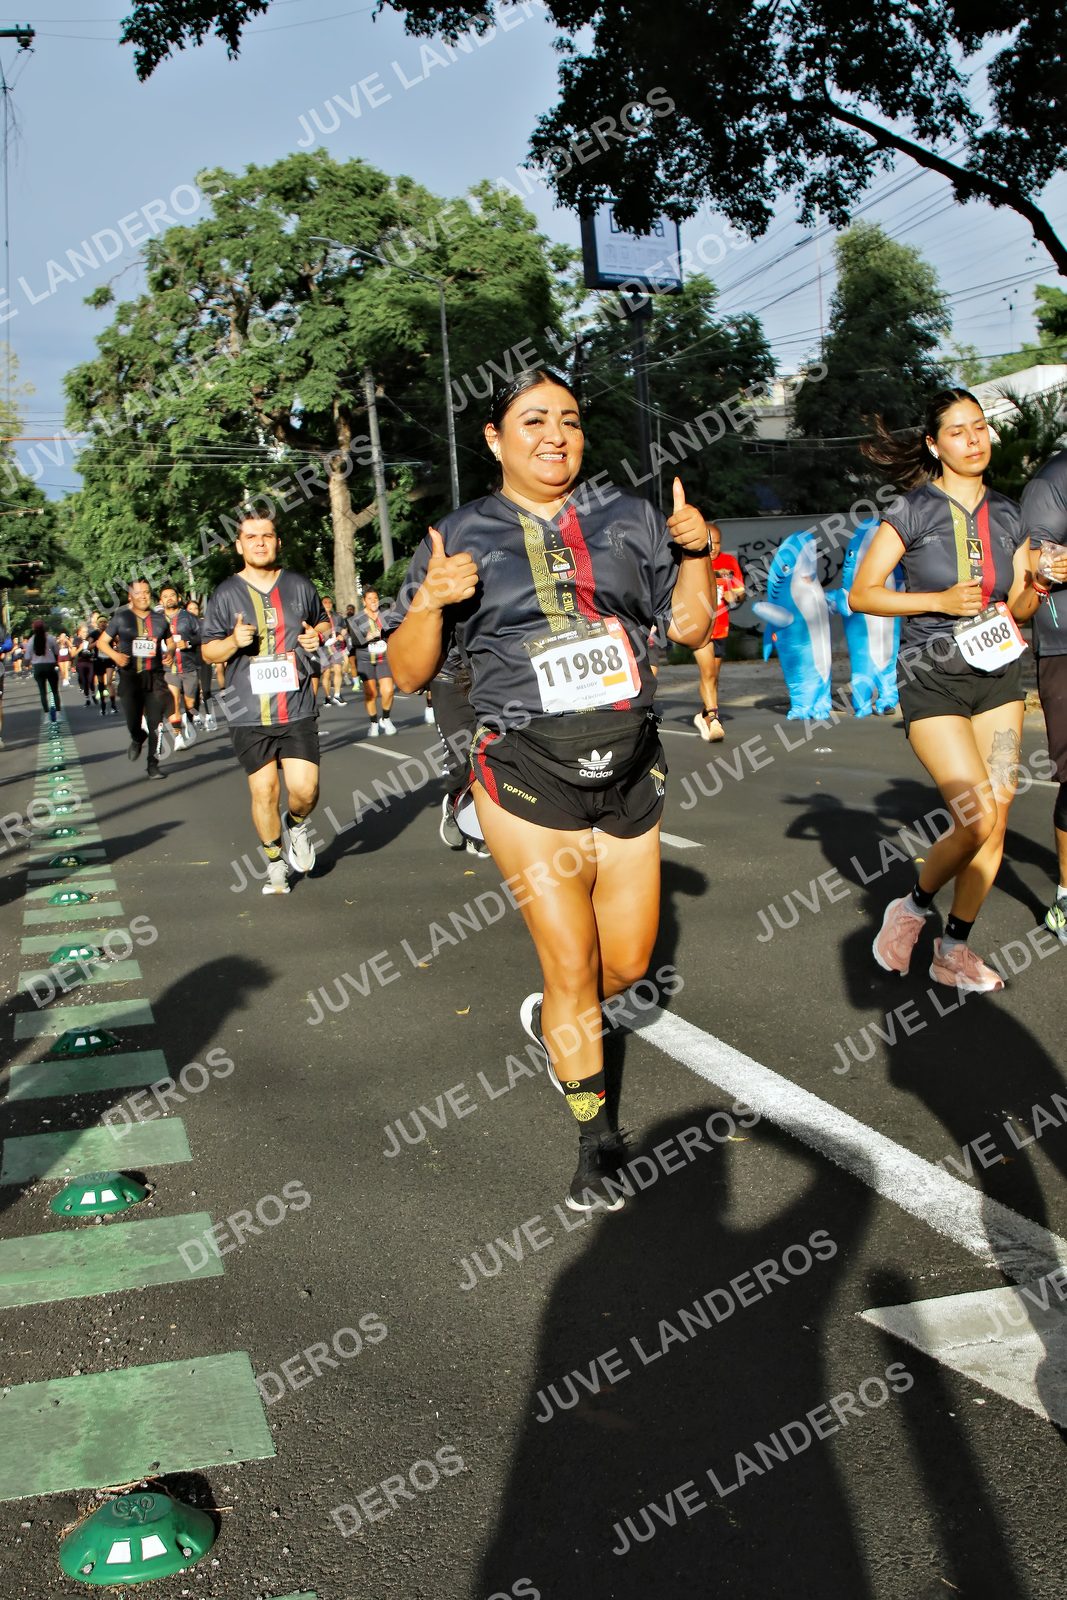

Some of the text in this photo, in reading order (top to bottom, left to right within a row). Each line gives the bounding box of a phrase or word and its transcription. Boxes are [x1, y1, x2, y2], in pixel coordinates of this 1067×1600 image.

[963, 622, 1011, 656] 11888
[256, 665, 288, 680] 8008
[539, 645, 623, 687] 11988
[578, 768, 614, 779] adidas
[502, 781, 538, 804] TOPTIME
